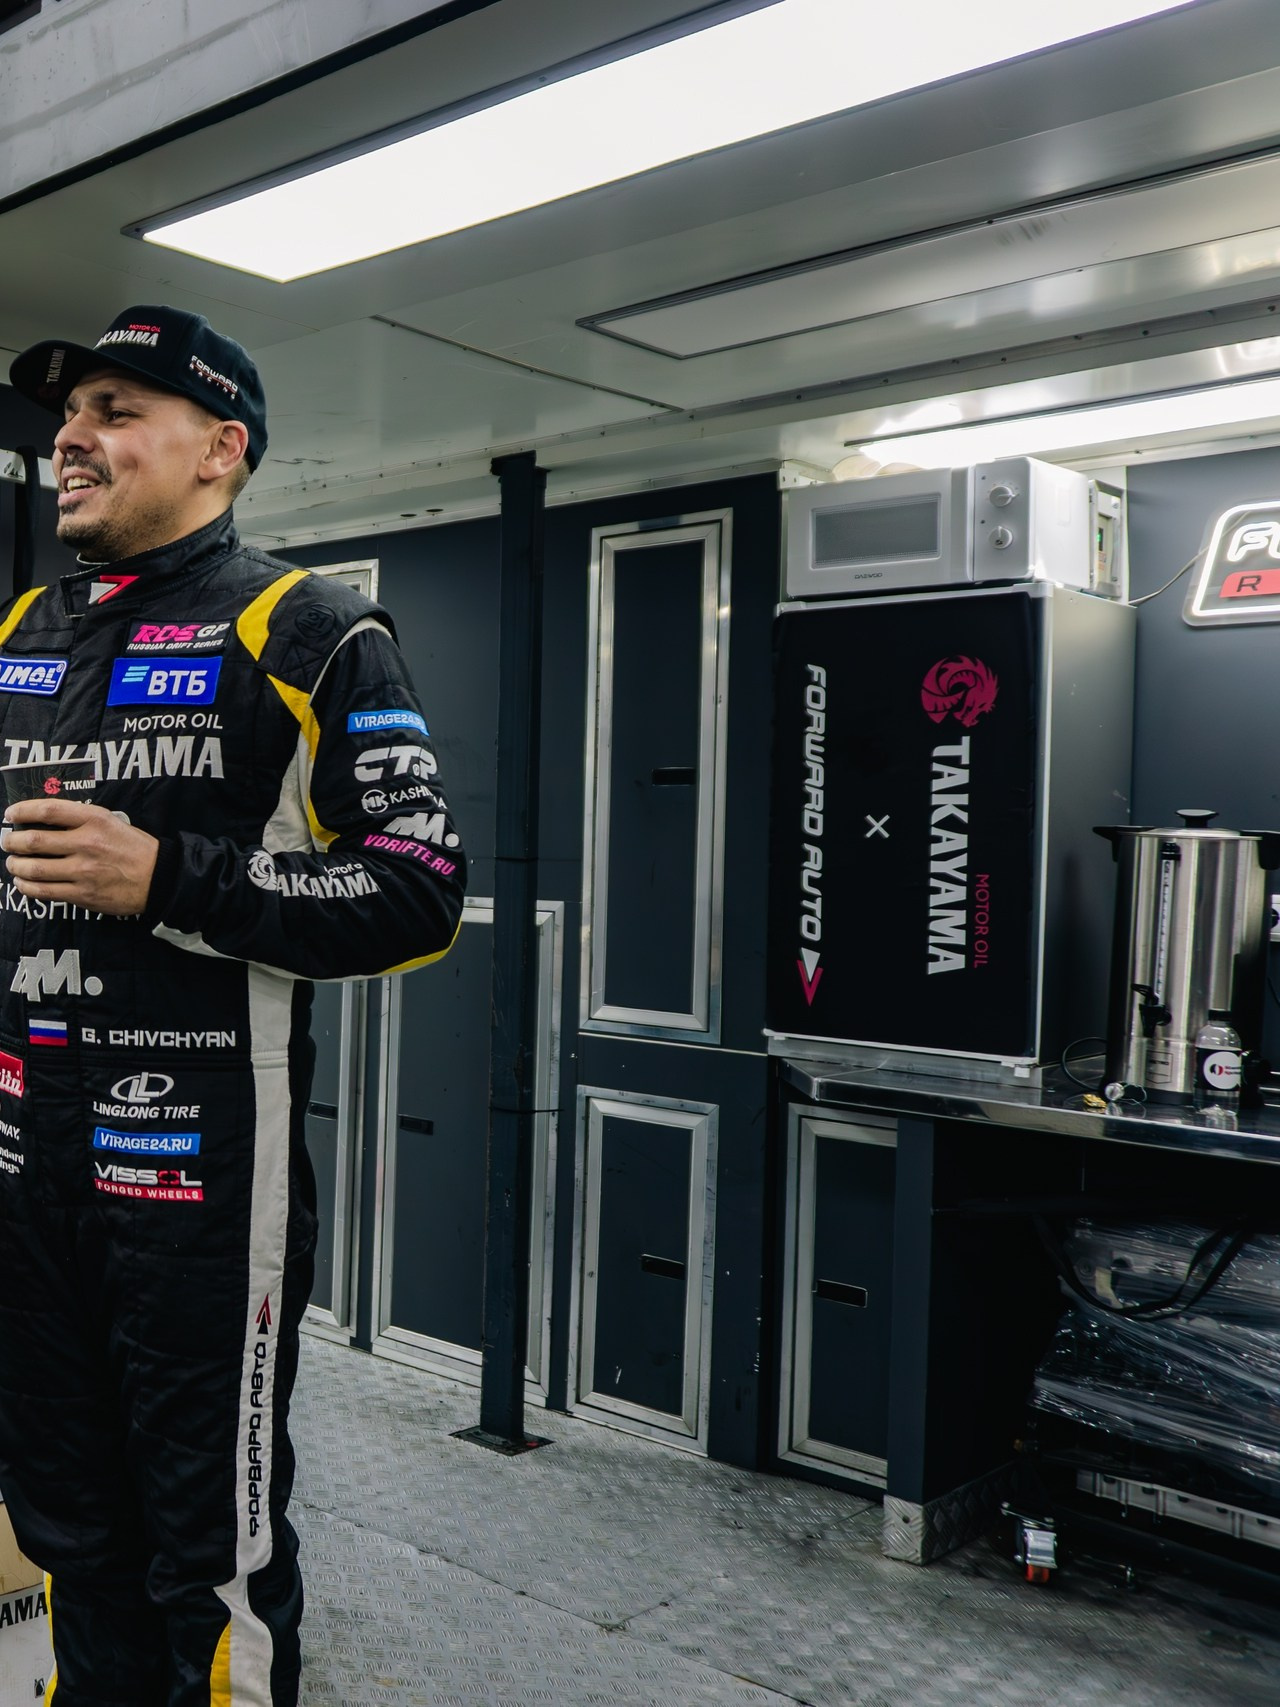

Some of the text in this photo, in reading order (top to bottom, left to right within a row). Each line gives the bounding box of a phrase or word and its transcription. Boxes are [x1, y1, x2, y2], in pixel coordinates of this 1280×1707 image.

[93, 330, 159, 347] KAYAMA
[191, 355, 238, 392] FORWARD
[854, 572, 883, 580] DAEWOO
[131, 622, 231, 643] RDS GP
[126, 638, 224, 651] RUSSIAN DRIFT SERIES
[147, 669, 208, 696] ВТБ
[123, 712, 223, 733] MOTOR OIL
[800, 663, 827, 942] FORWARD AUTO
[364, 834, 456, 876] VDRIFTE.RU
[927, 735, 970, 975] TAKAYAMA
[323, 862, 352, 876] OTOR
[276, 870, 381, 899] AKAYAMA
[973, 873, 989, 969] MOTOR OIL
[81, 1028, 236, 1048] G. CHIVCHYAN
[93, 1101, 201, 1120] LINGLONG TIRE
[100, 1132, 193, 1152] VIRAGE24.RU
[94, 1161, 203, 1187] VISSOL
[97, 1181, 200, 1200] FORGED WHEELS
